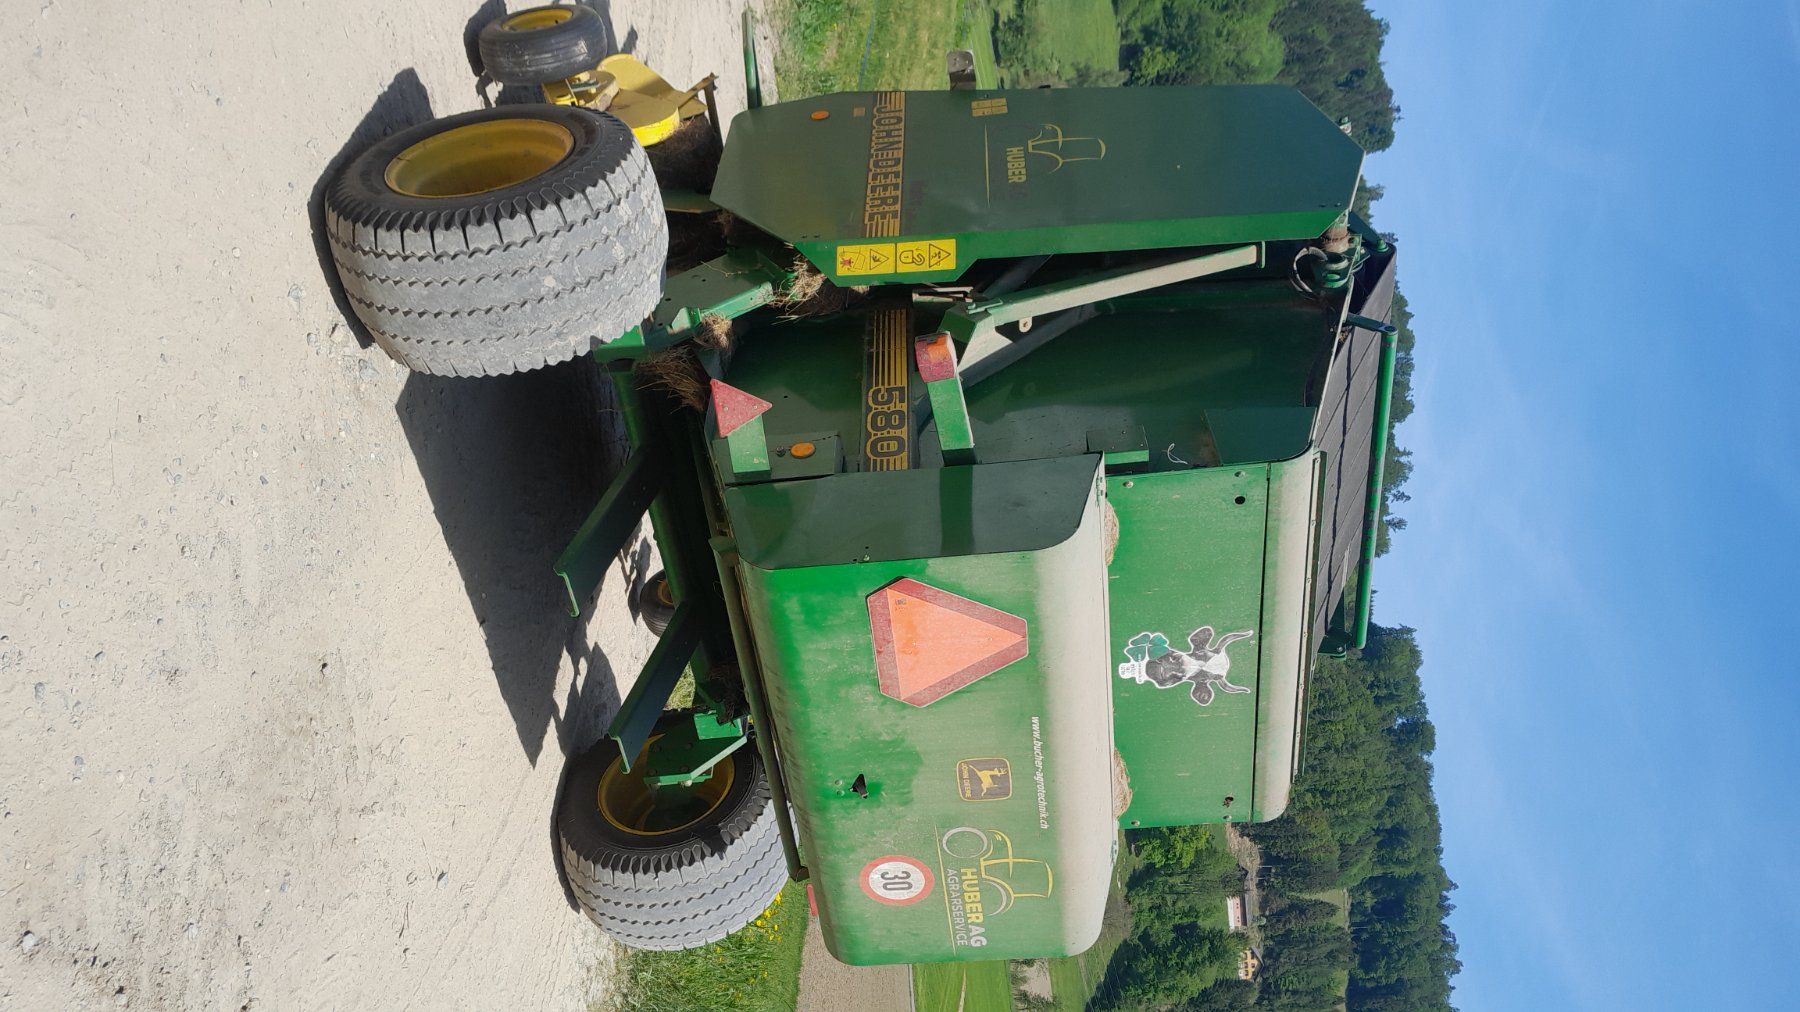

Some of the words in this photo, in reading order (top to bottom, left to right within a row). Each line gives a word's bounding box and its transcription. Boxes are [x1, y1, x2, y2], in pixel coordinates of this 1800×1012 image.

[872, 105, 904, 152] JOHN
[1006, 146, 1026, 183] HUBER
[864, 157, 901, 223] DEERE
[865, 386, 906, 459] 580
[961, 763, 970, 778] JOHN
[963, 780, 972, 798] DEERE
[1030, 716, 1048, 829] www.bucher-agrotechnik.ch
[880, 870, 913, 892] 30
[960, 868, 984, 923] HUBER
[946, 868, 968, 946] AGRARSERVICE
[968, 924, 987, 948] AG
